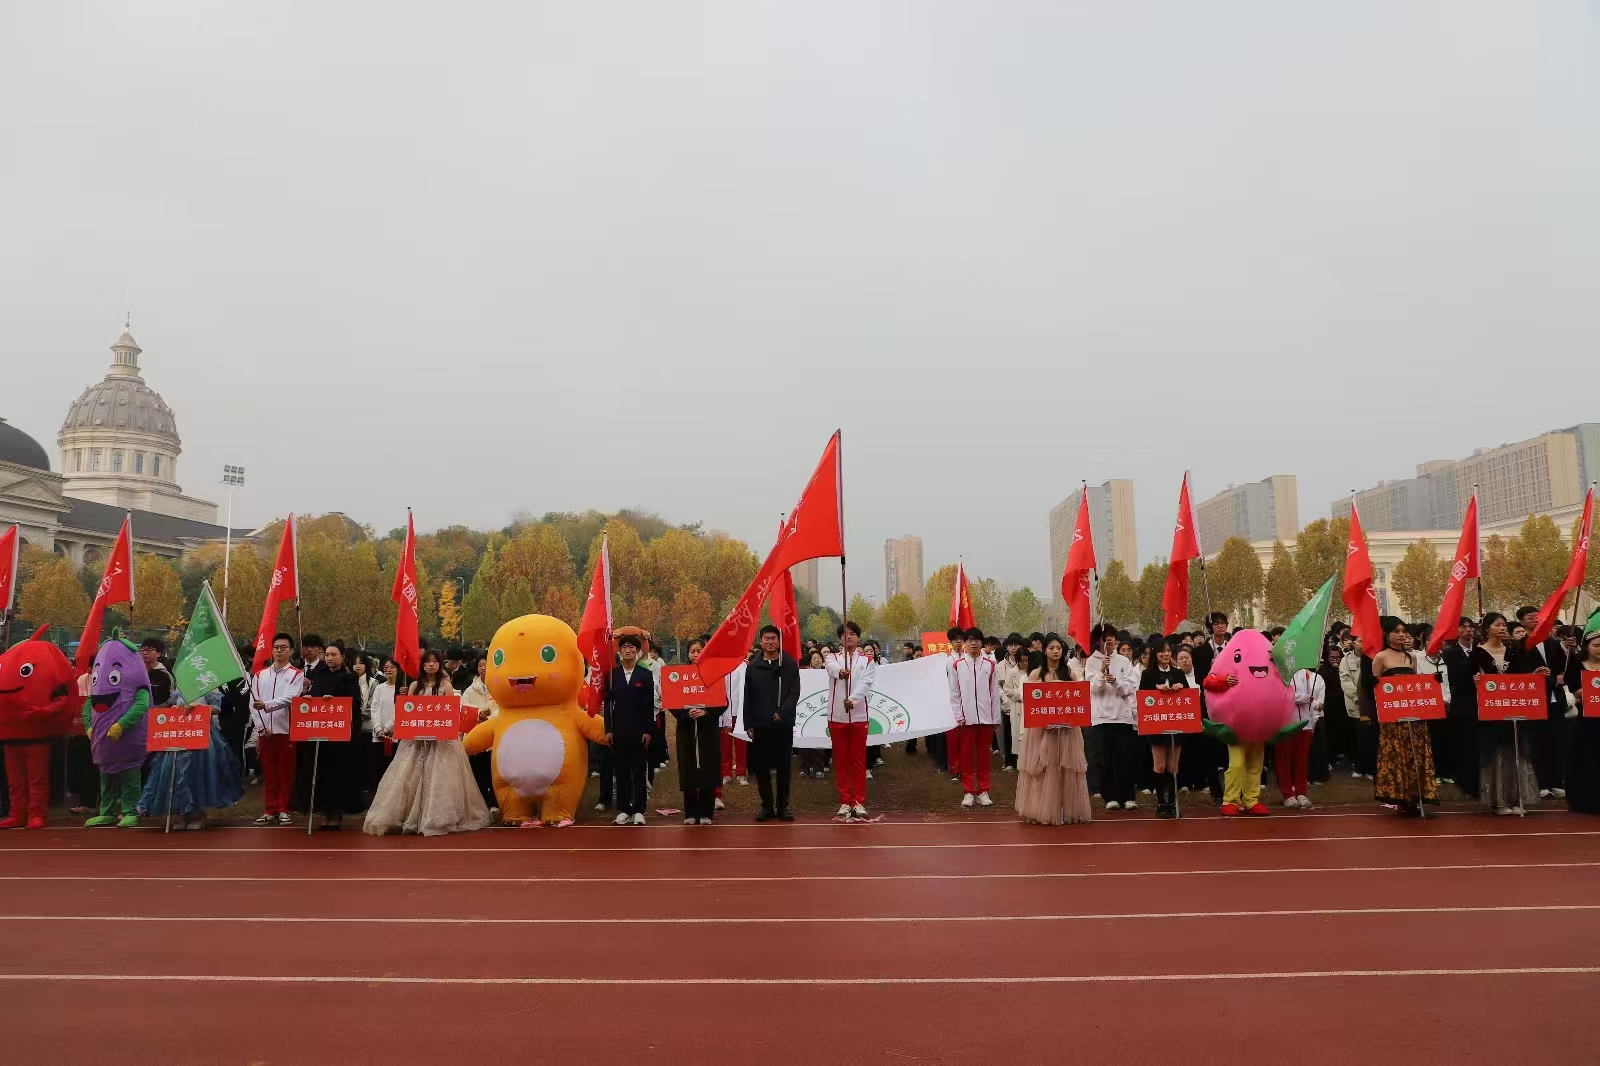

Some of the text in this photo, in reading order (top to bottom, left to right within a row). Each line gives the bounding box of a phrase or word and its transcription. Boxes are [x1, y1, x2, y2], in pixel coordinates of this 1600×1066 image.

[1499, 682, 1537, 691] 园艺学院
[1045, 689, 1081, 699] 园艺学院
[1157, 695, 1192, 706] 园艺学院
[1484, 698, 1540, 707] 25级园艺类7班
[311, 704, 344, 714] 园艺学院
[416, 703, 452, 713] 园艺学院
[1030, 705, 1085, 715] 25级园艺类1班
[1143, 712, 1196, 722] 25级园艺类3班
[296, 720, 346, 730] 25级园艺类4班
[400, 719, 453, 729] 25级园艺类2班
[153, 729, 204, 739] 25级园艺类6班
